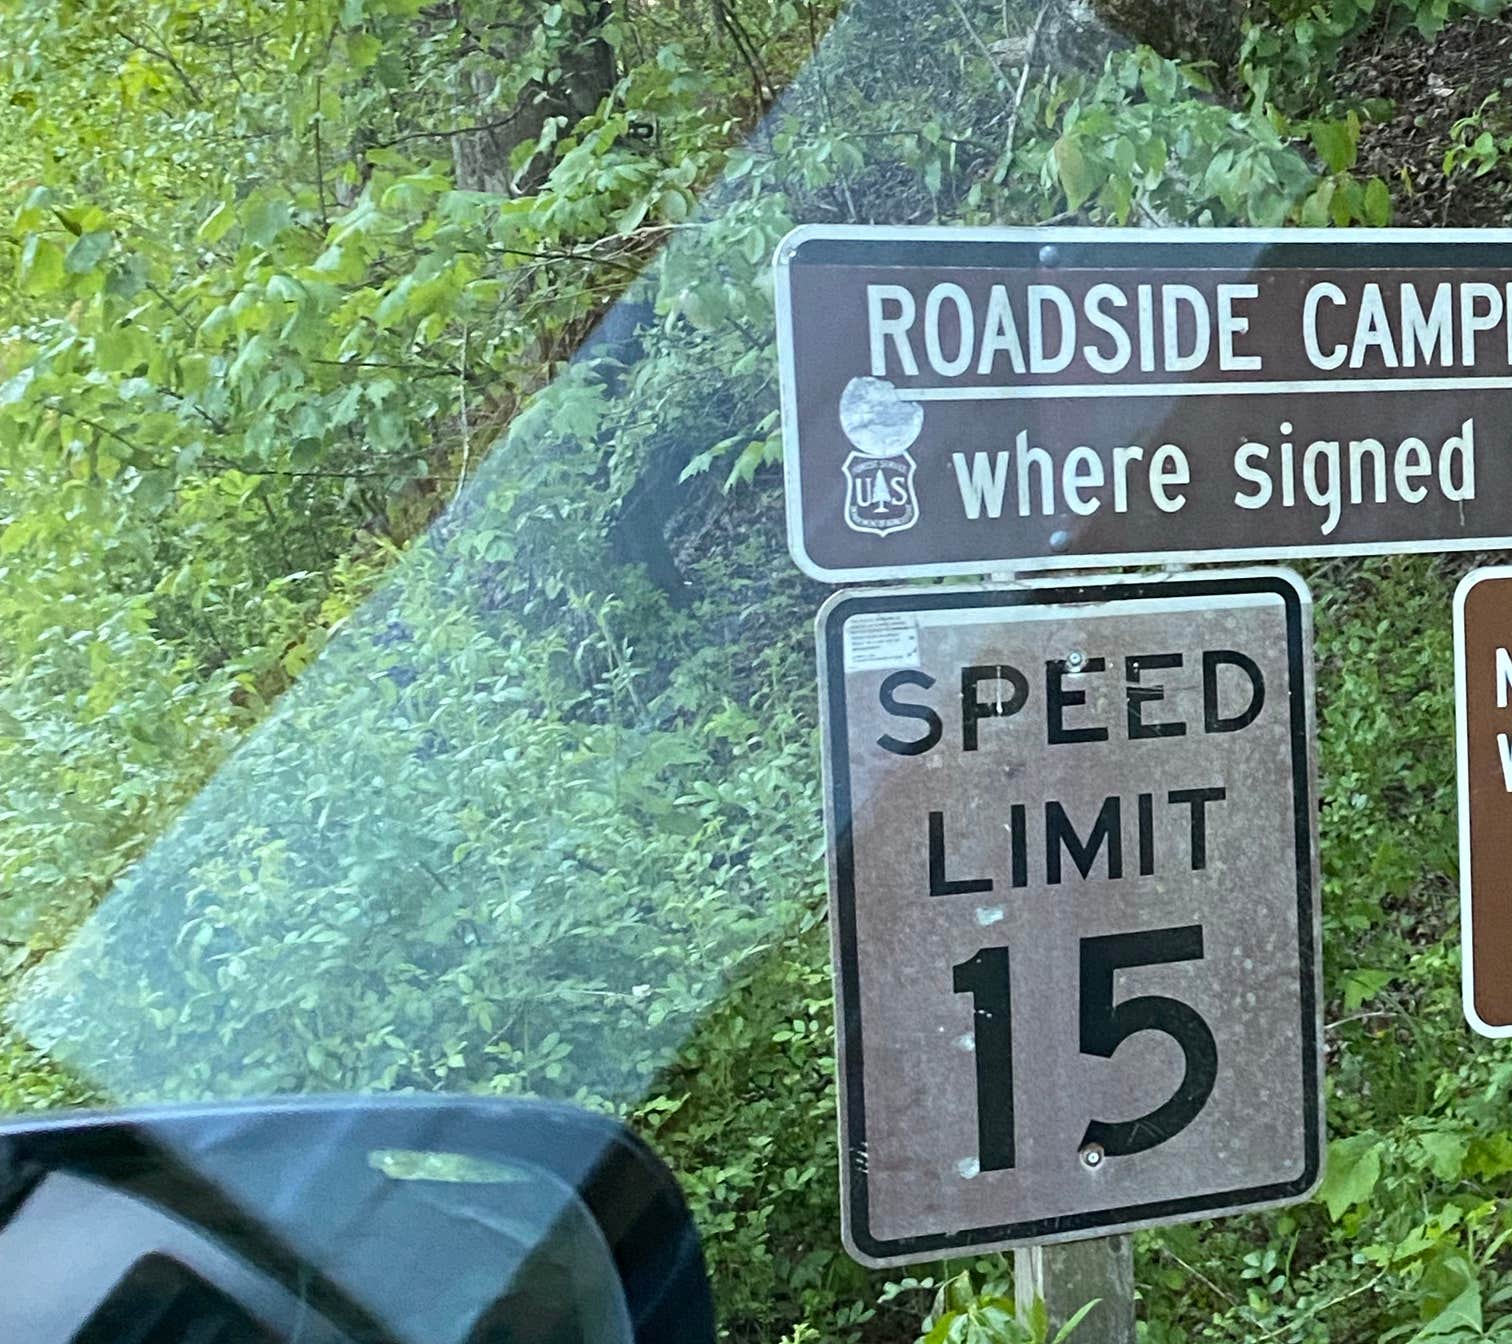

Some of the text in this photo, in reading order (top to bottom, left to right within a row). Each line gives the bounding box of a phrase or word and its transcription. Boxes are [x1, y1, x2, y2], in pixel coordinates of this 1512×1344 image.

[867, 282, 1262, 376] ROADSIDE
[952, 429, 1191, 520] where
[1233, 417, 1475, 535] signed
[878, 649, 1266, 756] SPEED
[928, 787, 1226, 897] LIMIT
[952, 925, 1219, 1173] 15
